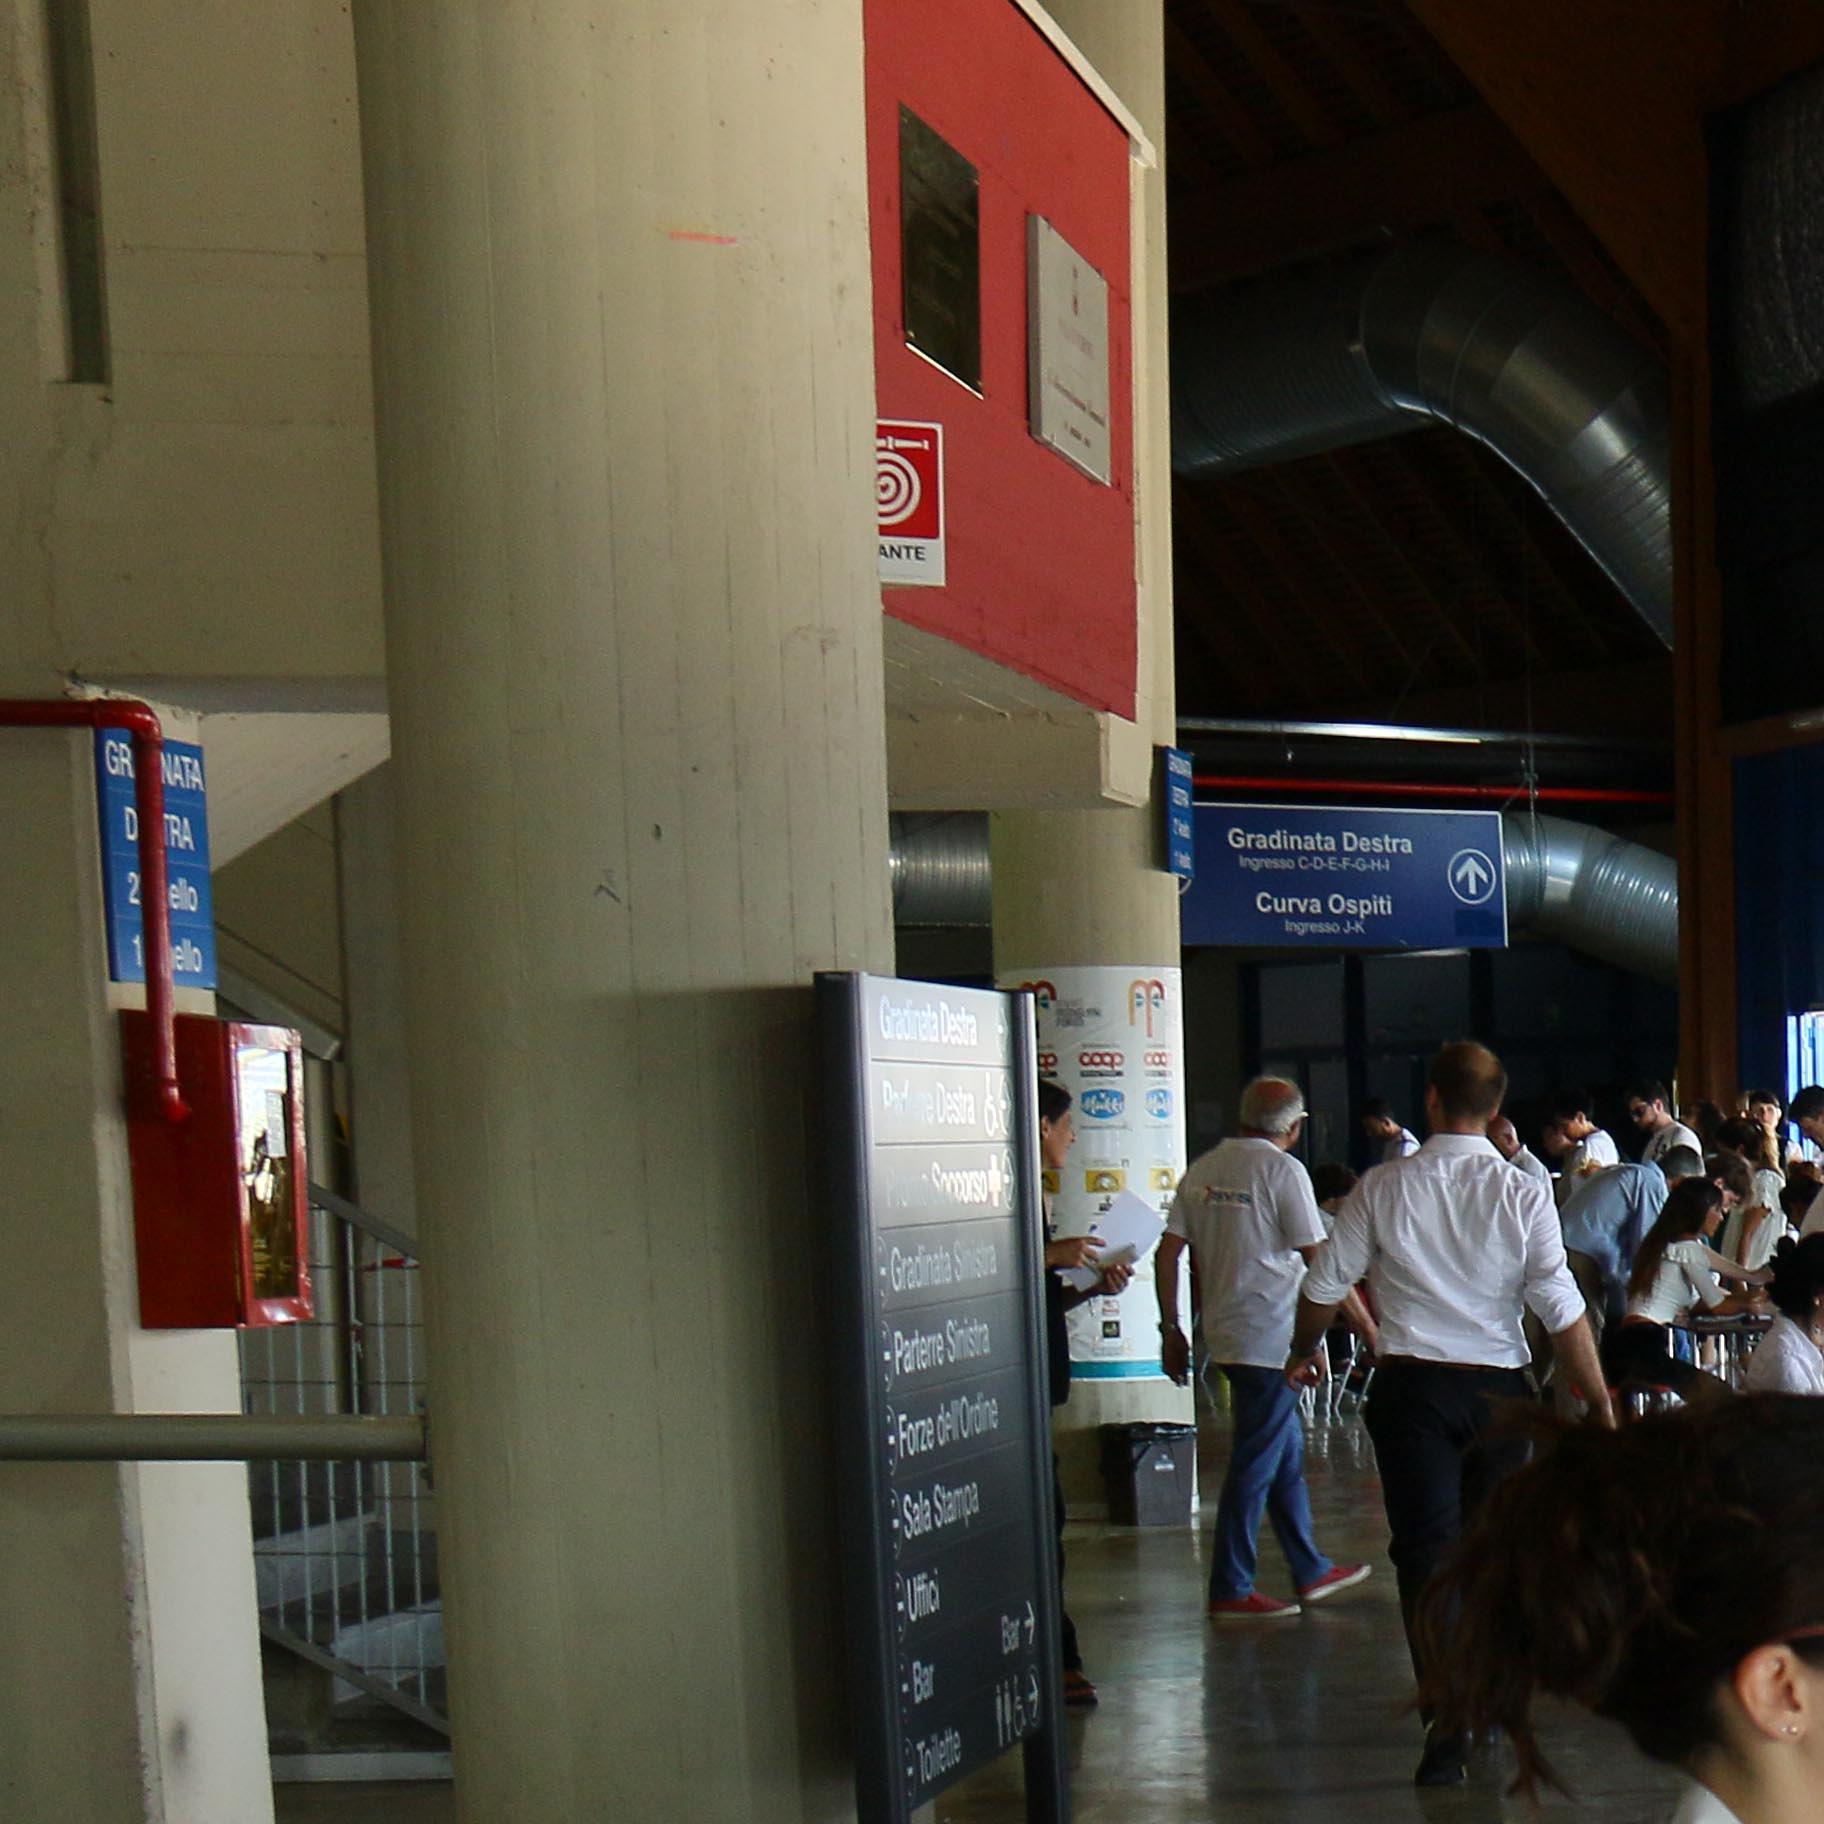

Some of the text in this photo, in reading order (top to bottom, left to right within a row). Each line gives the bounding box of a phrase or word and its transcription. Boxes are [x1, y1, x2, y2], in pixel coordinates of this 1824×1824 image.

[880, 544, 926, 560] ANTE
[104, 739, 205, 792] GRNATA
[124, 806, 195, 851] DTRA
[1227, 827, 1412, 854] Gradinata Destra
[1238, 855, 1390, 872] Ingresso C-D-E-F-G-H-I
[168, 877, 198, 912] ello
[1256, 891, 1392, 919] Curva Ospiti
[1285, 919, 1366, 936] Ingresso J-K
[173, 937, 202, 973] ello
[880, 995, 978, 1046] Gradinata Destra
[936, 1080, 976, 1125] Destra
[890, 1244, 952, 1292] Gradinata
[893, 1317, 991, 1375] Parterre Sinistra
[898, 1413, 935, 1459] Forze
[903, 1481, 980, 1540] Sala Stampa
[906, 1568, 940, 1622] Uffici
[912, 1659, 934, 1704] Bar
[916, 1727, 962, 1784] Toilette
